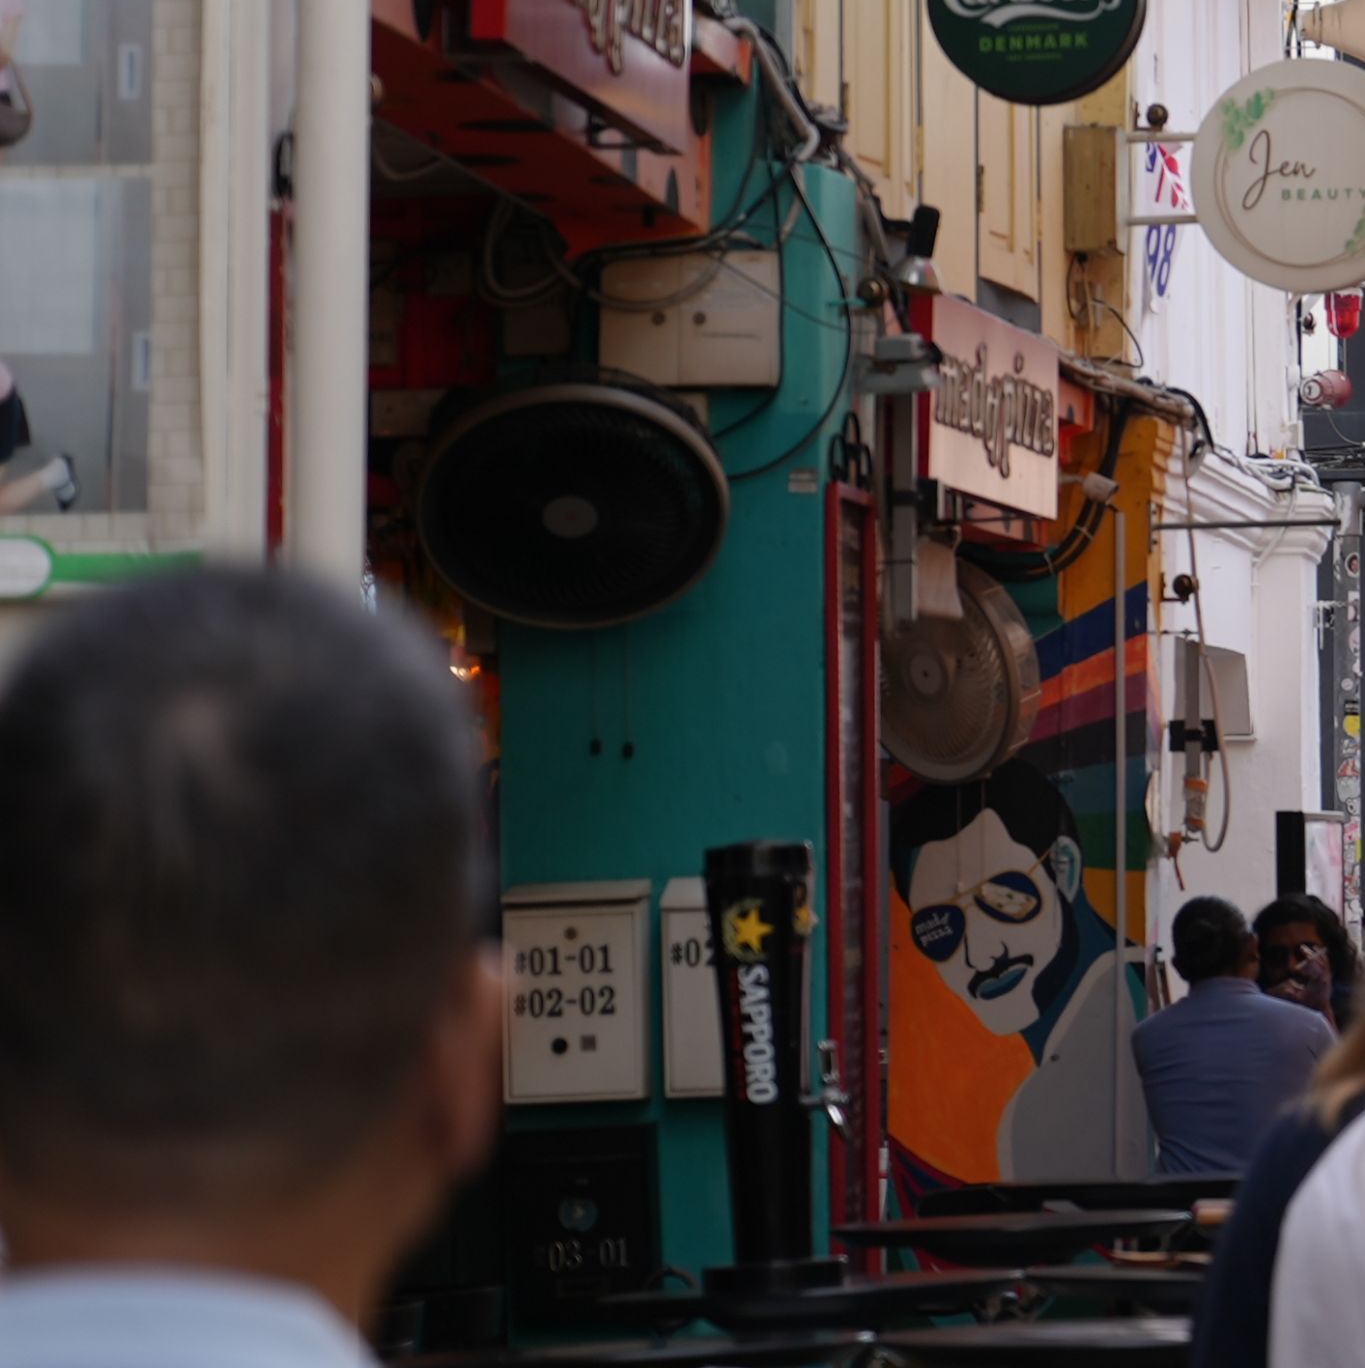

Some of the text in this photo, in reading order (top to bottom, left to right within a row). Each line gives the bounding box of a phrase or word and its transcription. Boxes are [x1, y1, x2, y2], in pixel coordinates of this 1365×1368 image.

[978, 32, 1089, 53] DENMARK
[1242, 129, 1317, 211] Jen
[513, 944, 614, 976] #01-01
[513, 985, 617, 1019] #02-02
[737, 963, 778, 1106] SAPPORO
